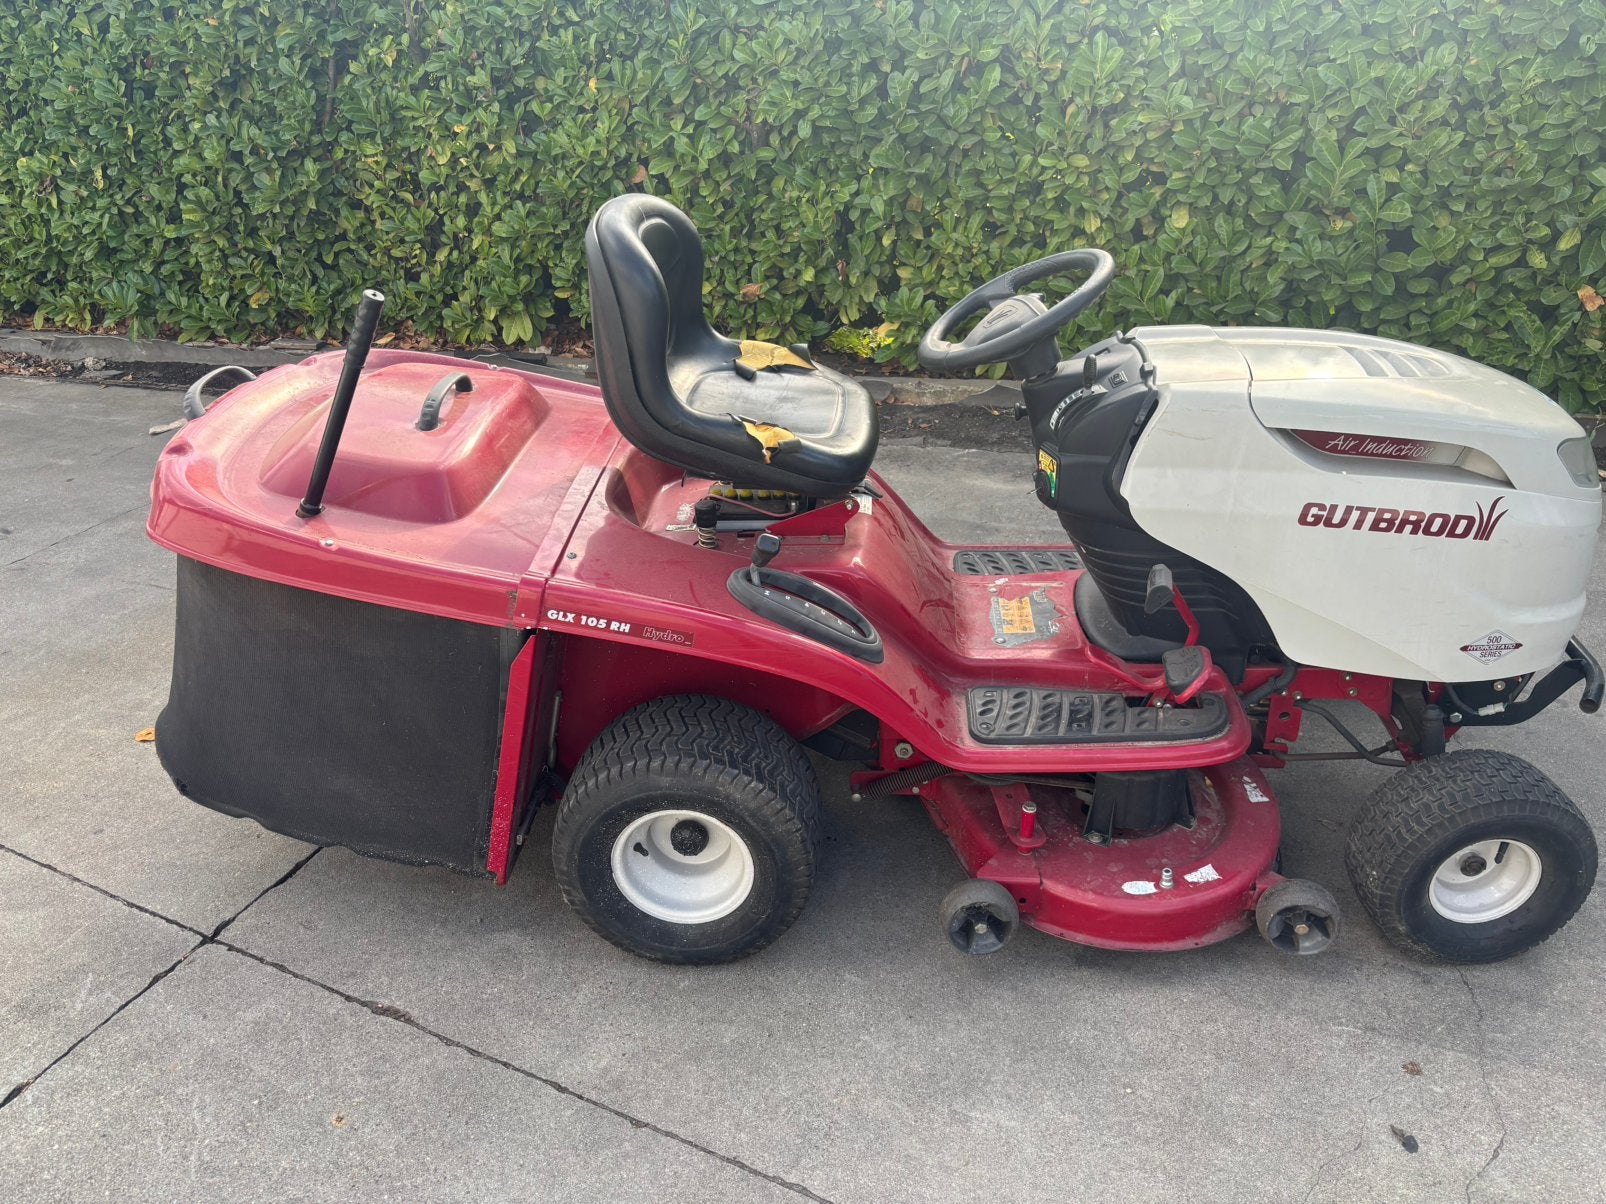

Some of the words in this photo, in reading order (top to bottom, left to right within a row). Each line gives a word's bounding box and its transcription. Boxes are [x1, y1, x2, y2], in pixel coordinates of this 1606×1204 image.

[1325, 434, 1359, 452] Air
[1359, 438, 1434, 458] Induction
[1298, 502, 1477, 539] GUTBROD
[547, 609, 576, 622] GLX
[580, 615, 608, 629] 105
[609, 621, 631, 633] RH
[1487, 635, 1502, 644] 500
